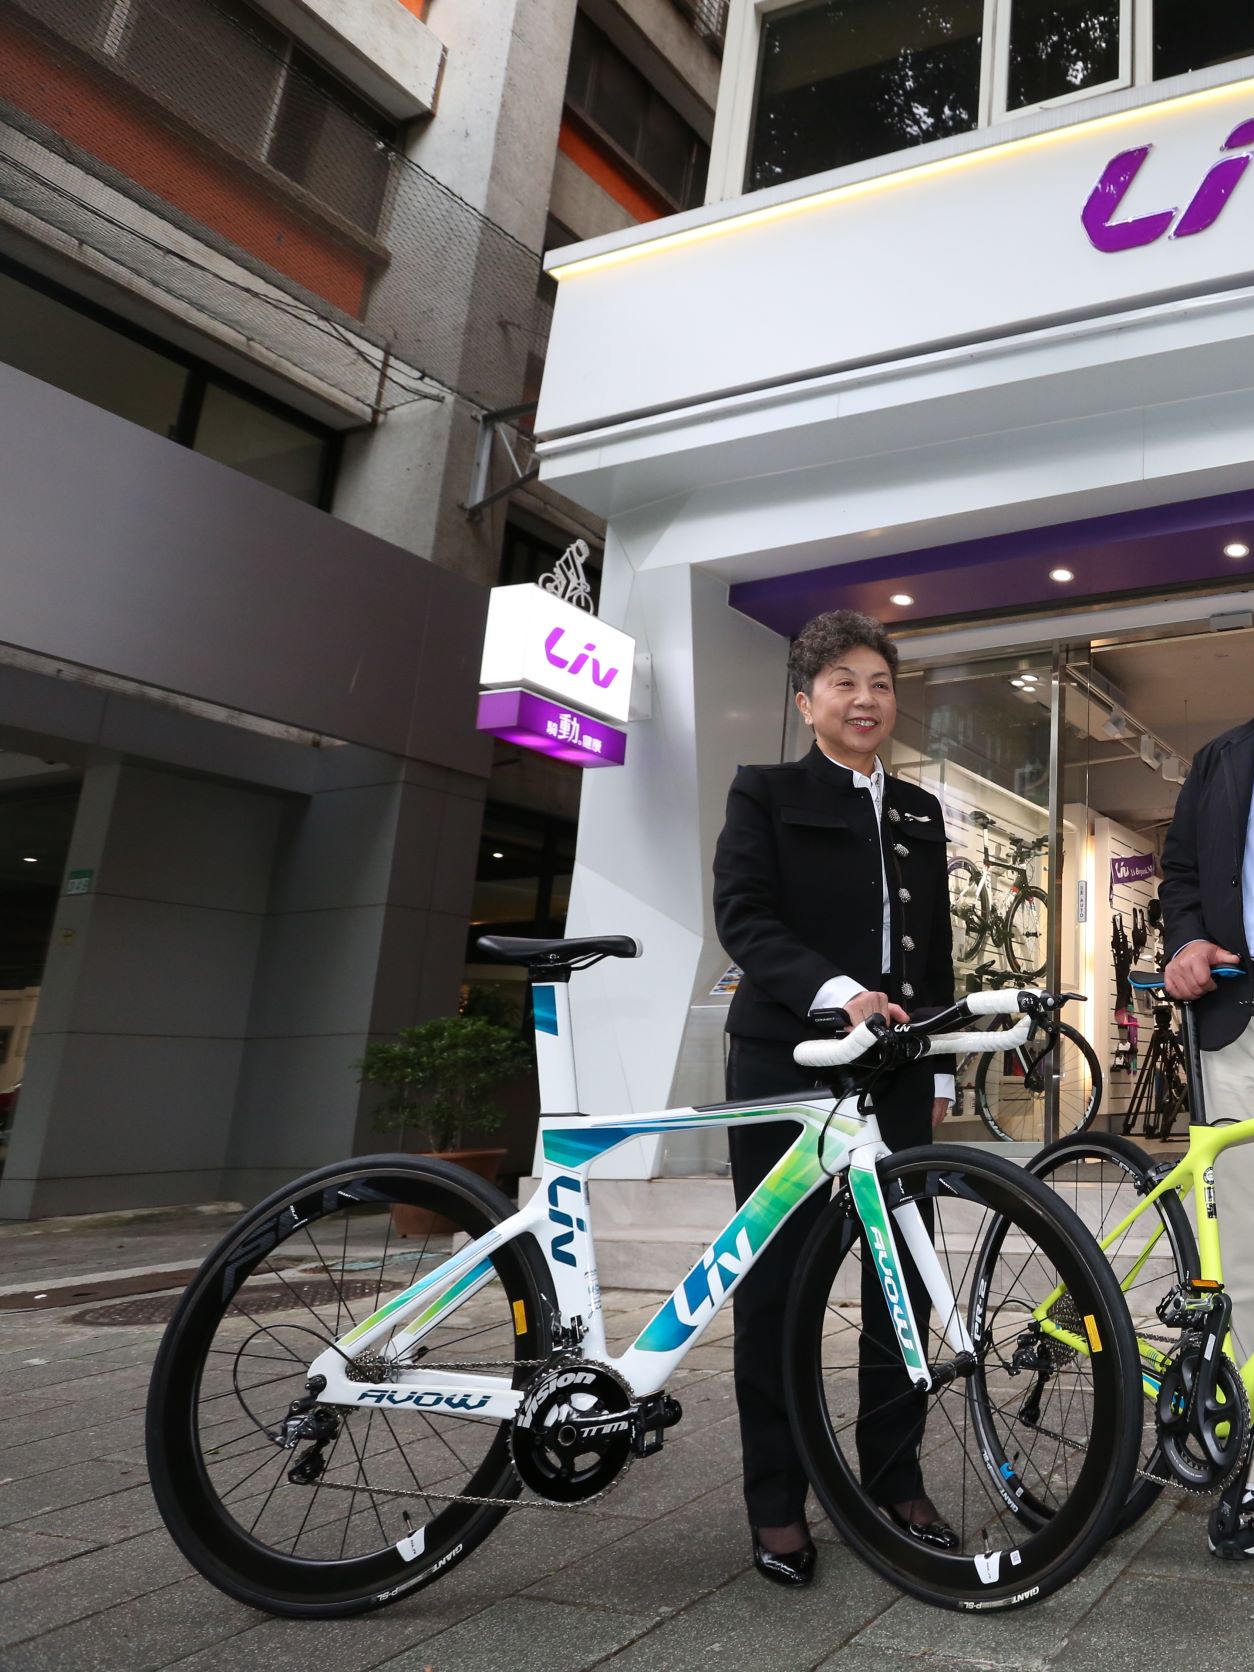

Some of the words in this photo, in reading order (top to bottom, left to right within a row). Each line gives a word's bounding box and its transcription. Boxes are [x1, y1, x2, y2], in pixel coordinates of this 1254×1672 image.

[545, 627, 618, 688] Liv
[894, 1023, 911, 1033] Liv
[547, 1175, 587, 1267] Liv
[673, 1226, 756, 1327] Liv
[1000, 1489, 1019, 1513] GIANT
[431, 1543, 463, 1573] GIANT
[376, 1587, 400, 1602] P-SL
[963, 1601, 983, 1610] P-SL
[1011, 1585, 1040, 1604] GIANT
